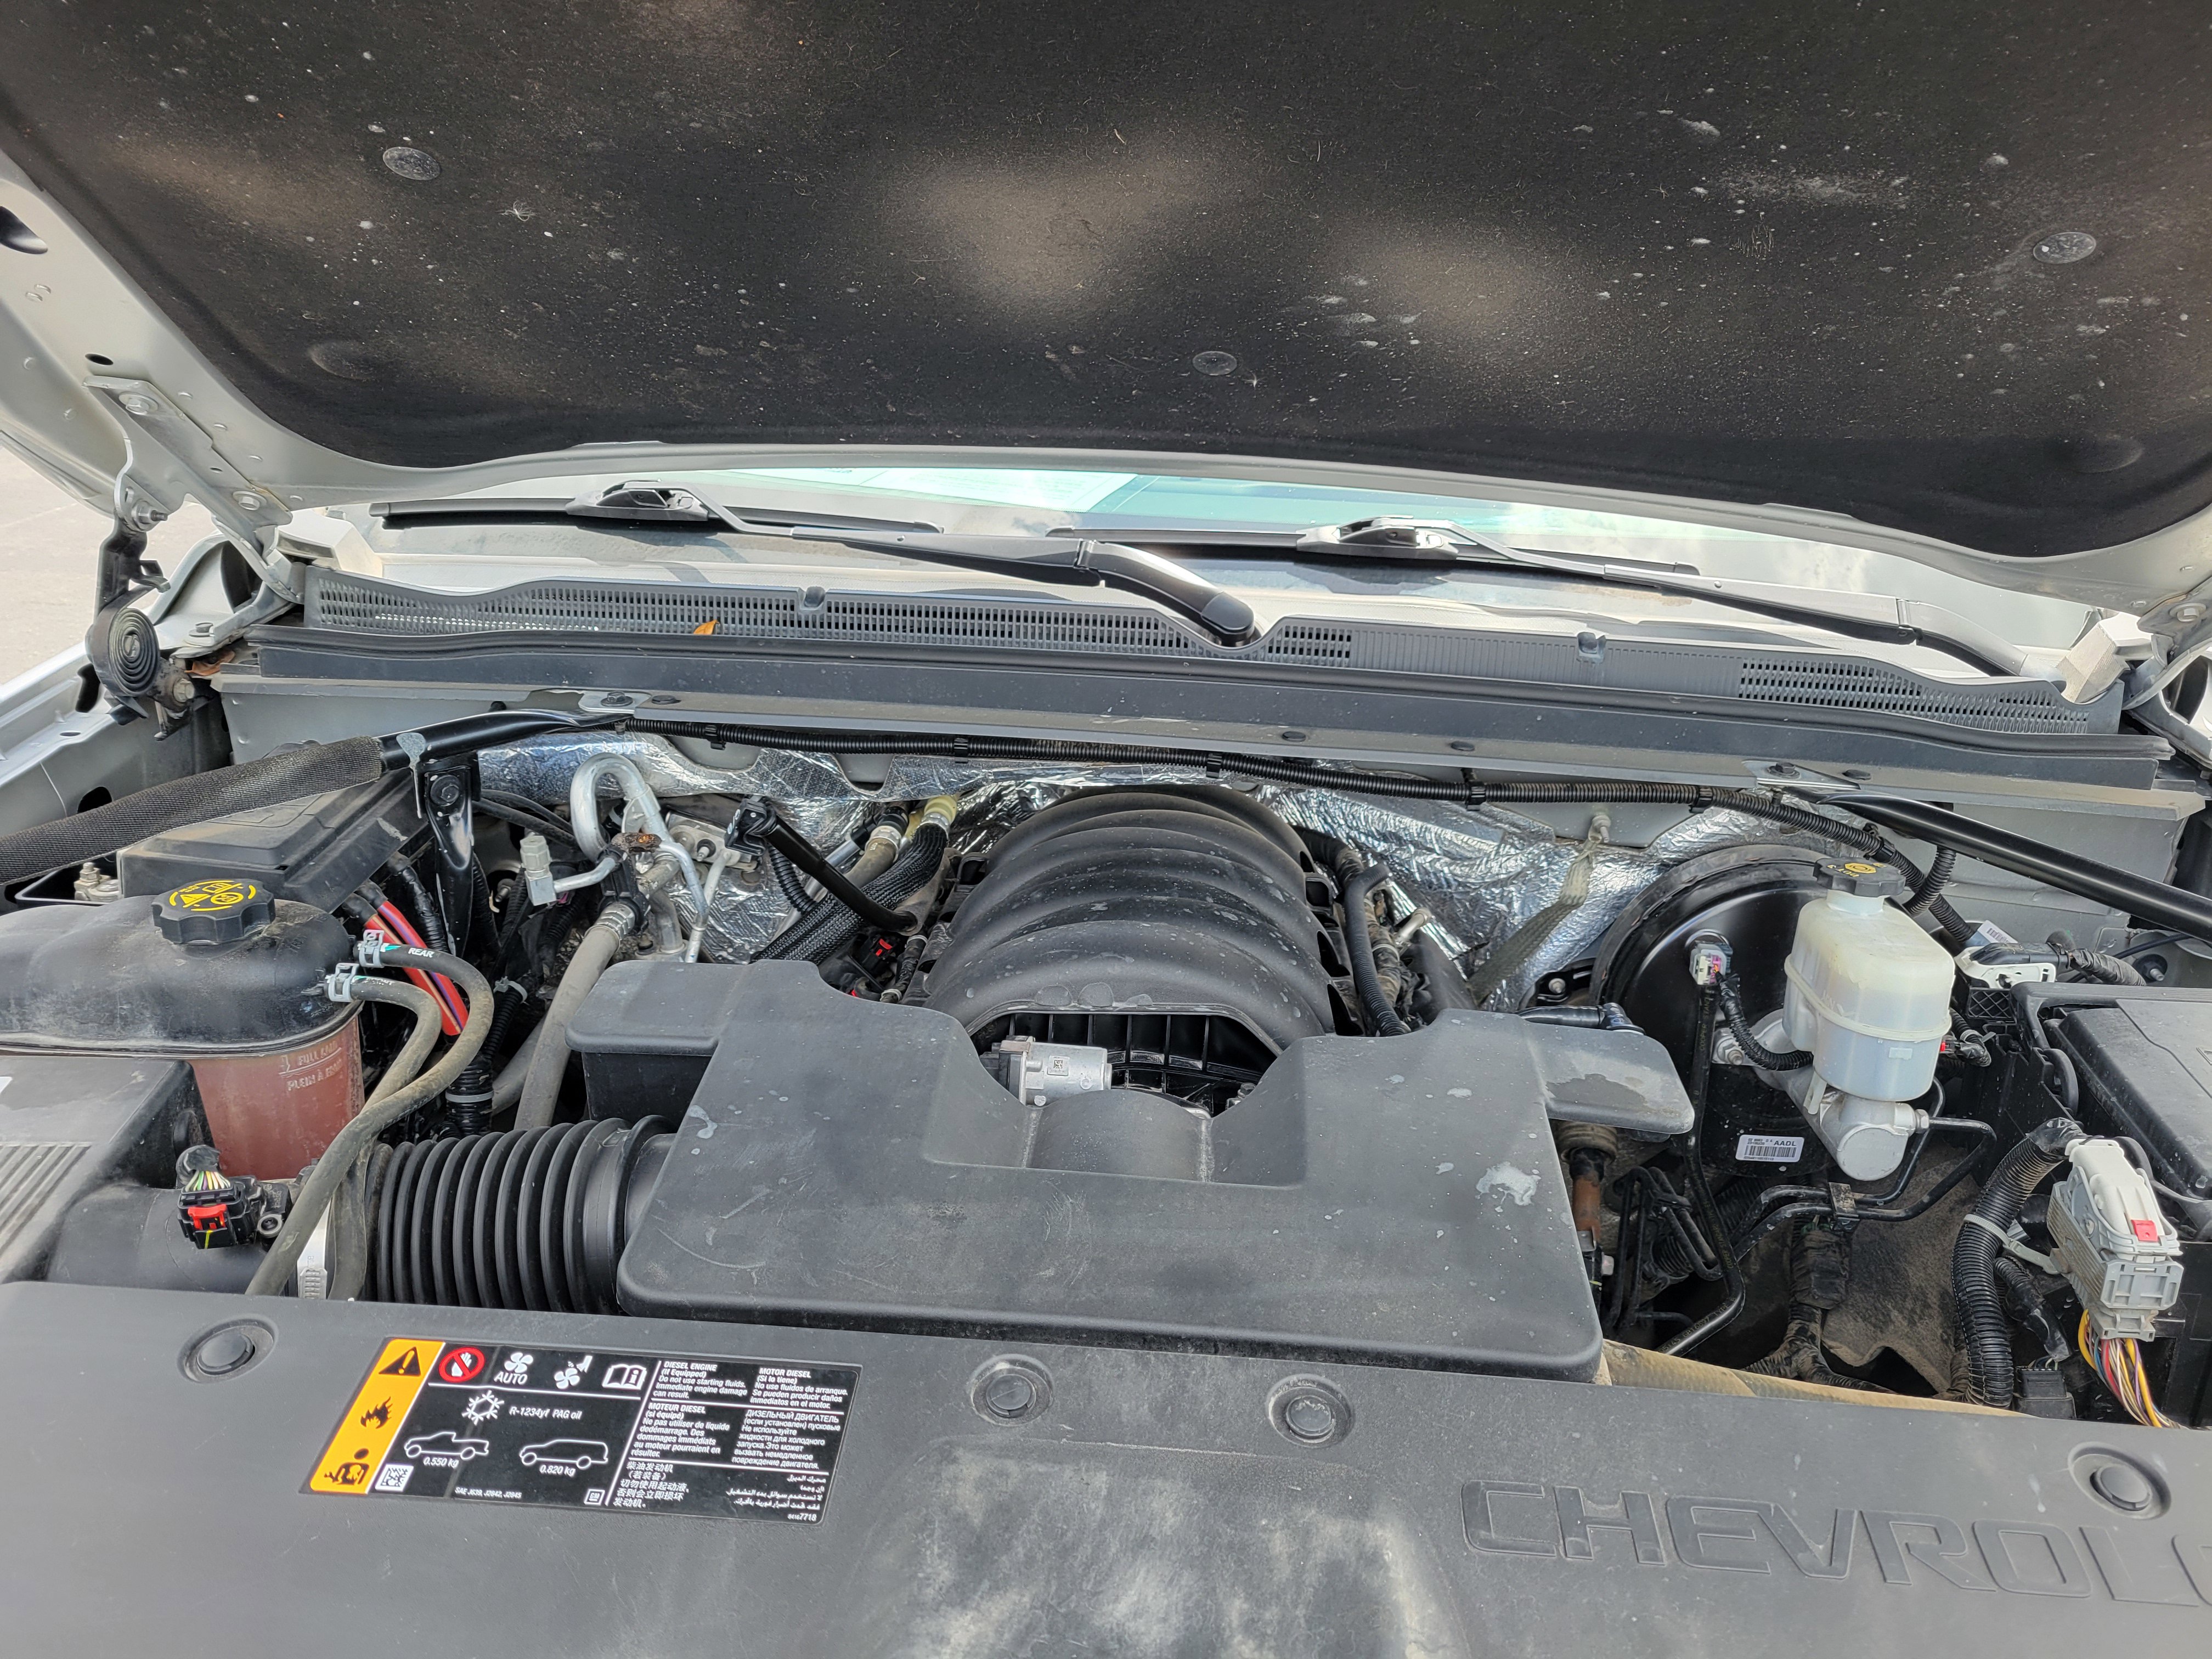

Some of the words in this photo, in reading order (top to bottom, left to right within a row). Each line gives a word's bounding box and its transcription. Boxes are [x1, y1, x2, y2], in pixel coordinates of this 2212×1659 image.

[408, 947, 435, 958] REAR
[298, 1051, 319, 1065] FULL
[287, 1075, 316, 1091] PLEIN
[663, 1361, 689, 1369] DIESEL
[690, 1363, 718, 1372] ENGINE
[494, 1372, 528, 1385] AUTO
[670, 1369, 707, 1379] Equipped)
[759, 1368, 785, 1376] MOTOR
[786, 1369, 811, 1378] DIESEL
[696, 1379, 724, 1387] starting
[725, 1380, 746, 1388] fluids.
[757, 1375, 767, 1384] (Si
[777, 1376, 798, 1385] tiene)
[656, 1383, 692, 1391] Immediate
[694, 1386, 718, 1394] engine
[719, 1387, 747, 1396] damage
[780, 1384, 804, 1392] fluidos
[815, 1387, 848, 1396] arranque.
[750, 1397, 788, 1406] inmediatos
[763, 1390, 789, 1398] pueden
[791, 1392, 820, 1400] producir
[821, 1394, 843, 1402] daños
[509, 1406, 550, 1419] R-1234yf
[552, 1409, 569, 1419] PAG
[571, 1411, 582, 1420] oil
[648, 1403, 679, 1412] MOTEUR
[680, 1405, 706, 1414] DIESEL
[656, 1410, 684, 1420] équipé)
[745, 1409, 794, 1420] ДИЗЕЛЬНЫЙ
[794, 1413, 839, 1423] ДВИГАТЕЛЬ
[668, 1420, 694, 1428] utiliser
[706, 1422, 730, 1431] liquide
[743, 1417, 763, 1425] (если
[764, 1419, 806, 1430] установлен)
[808, 1423, 841, 1431] пусковые
[753, 1426, 797, 1435] используйте
[636, 1433, 676, 1443] dommages
[678, 1436, 716, 1445] immédiats
[788, 1437, 825, 1446] холодного
[631, 1449, 660, 1458] résulter.
[672, 1444, 710, 1453] pourraient
[734, 1449, 764, 1457] вызвать
[765, 1451, 814, 1460] немедленное
[422, 1457, 447, 1466] 0.550
[447, 1458, 459, 1469] kg
[627, 1461, 673, 1473] 柴油发动机
[731, 1456, 780, 1466] повреждение
[780, 1461, 819, 1470] двигателя.
[539, 1464, 563, 1475] 0.820
[564, 1466, 575, 1477] kg
[455, 1487, 467, 1495] SAE
[467, 1488, 483, 1497] J639,
[483, 1489, 503, 1498] J2842,
[503, 1491, 522, 1499] J2845
[617, 1488, 685, 1502] 否则会立即损坏
